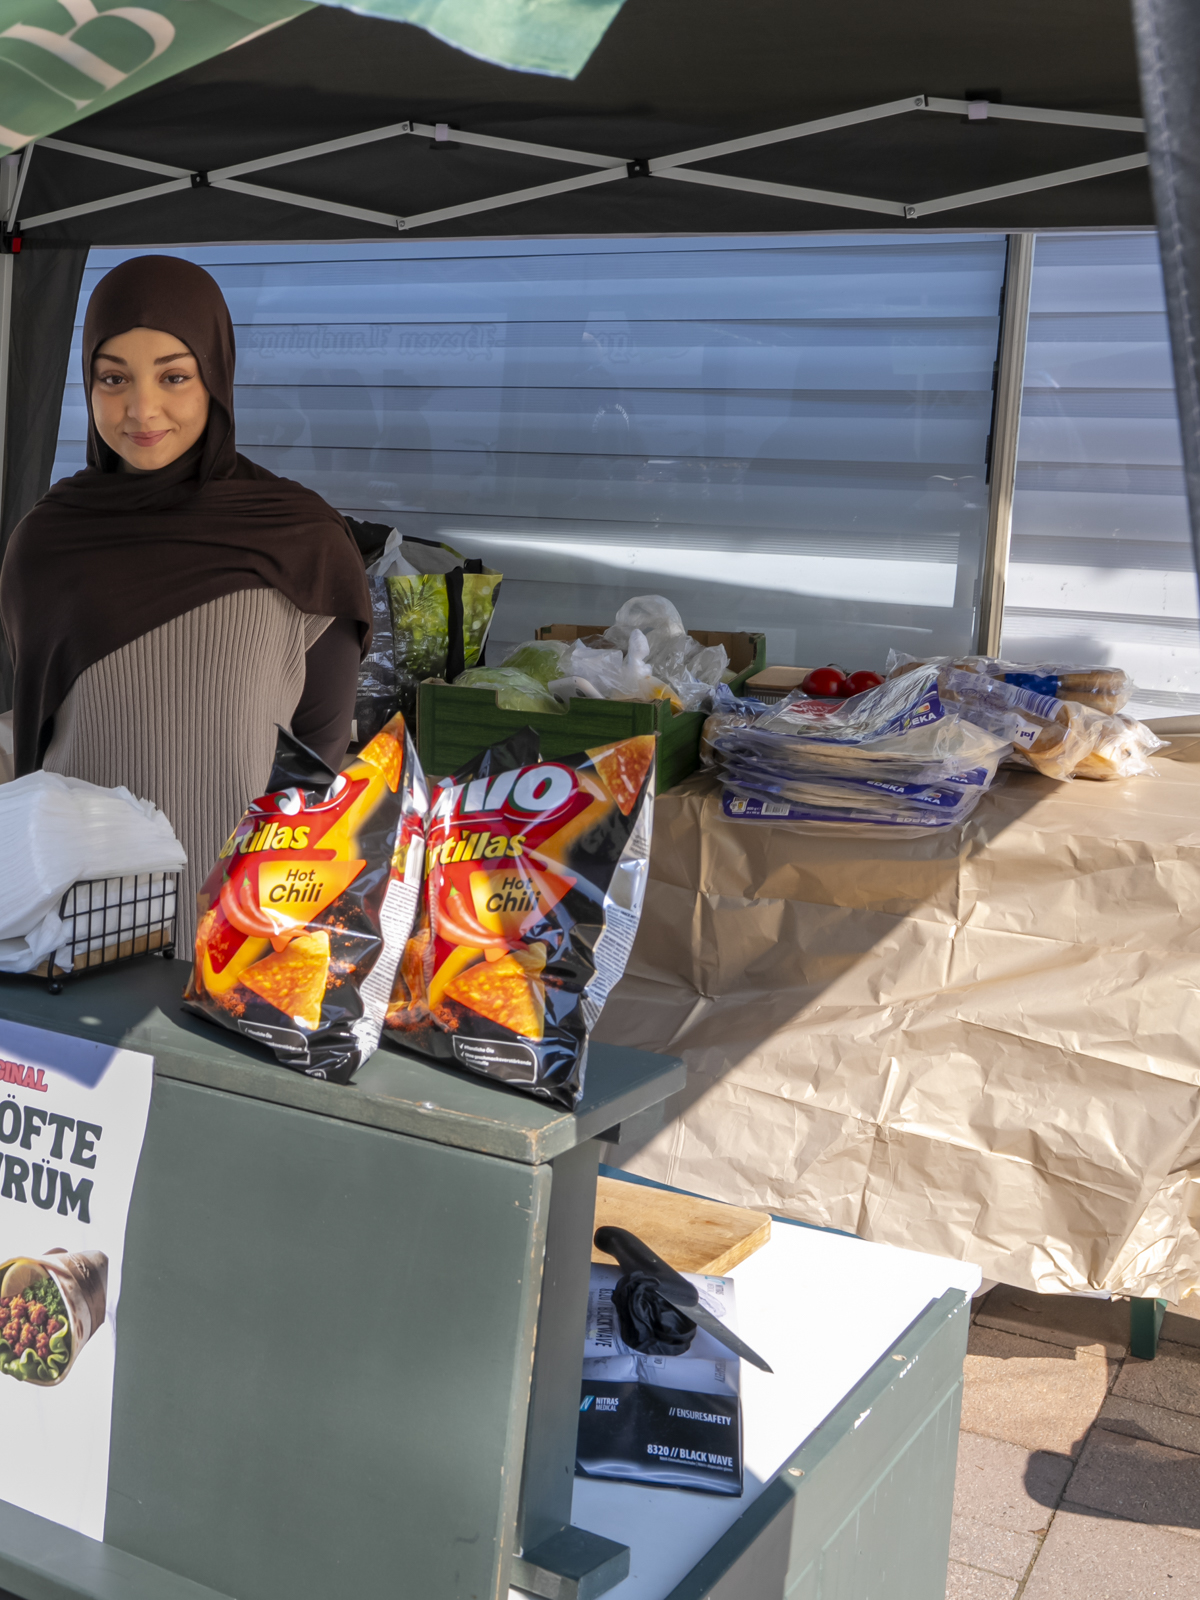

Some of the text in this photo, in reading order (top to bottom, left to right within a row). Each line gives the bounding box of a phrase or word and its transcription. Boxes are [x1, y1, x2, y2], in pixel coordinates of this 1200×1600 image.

[912, 713, 936, 725] EKA
[867, 780, 904, 793] EDEKA
[896, 817, 937, 825] EDEKA
[218, 820, 311, 859] ortillas
[285, 868, 316, 882] Hot
[501, 876, 533, 890] Hot
[268, 882, 323, 902] Chili
[486, 890, 541, 912] Chili
[595, 1327, 612, 1348] WAVE
[596, 1397, 619, 1407] NITRAS
[676, 1408, 731, 1426] ENSURESAFETY
[647, 1444, 669, 1456] 8320
[679, 1449, 708, 1463] BLACK
[708, 1452, 733, 1467] WAVE
